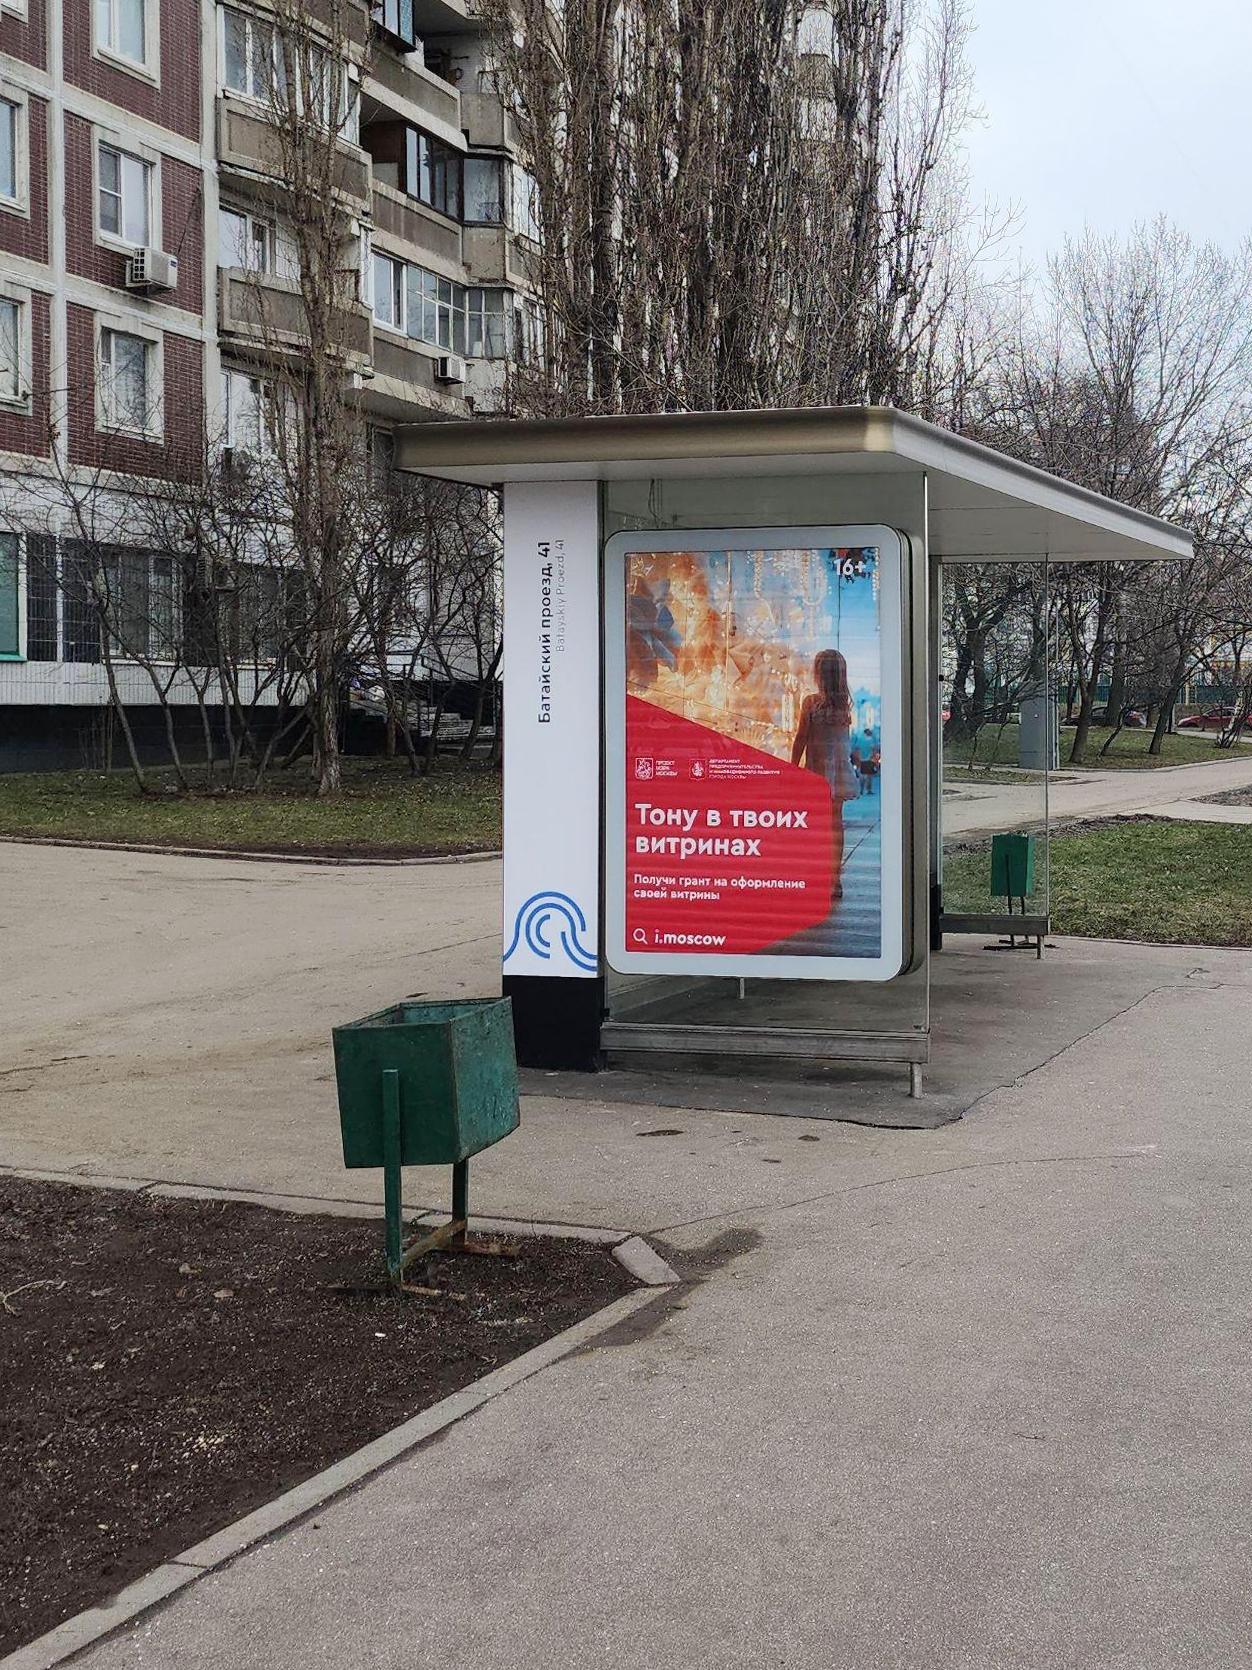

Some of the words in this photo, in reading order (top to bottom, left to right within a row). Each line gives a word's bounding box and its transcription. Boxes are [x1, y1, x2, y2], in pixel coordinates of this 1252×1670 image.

[537, 542, 550, 558] 41
[555, 539, 565, 550] 41
[555, 552, 567, 595] Proezd,
[833, 558, 867, 576] 16+
[541, 562, 554, 629] проезд,
[555, 597, 567, 652] Batayskiy
[537, 633, 551, 724] Батайский
[635, 803, 699, 832] Тону
[707, 809, 721, 826] в
[729, 810, 808, 828] твоих
[635, 836, 761, 860] витринах
[634, 873, 676, 888] Получи
[679, 876, 711, 887] грант
[714, 877, 728, 887] на
[731, 876, 806, 890] оформление
[633, 887, 667, 898] своей
[671, 891, 720, 901] витрины
[654, 928, 726, 946] i.moscow
